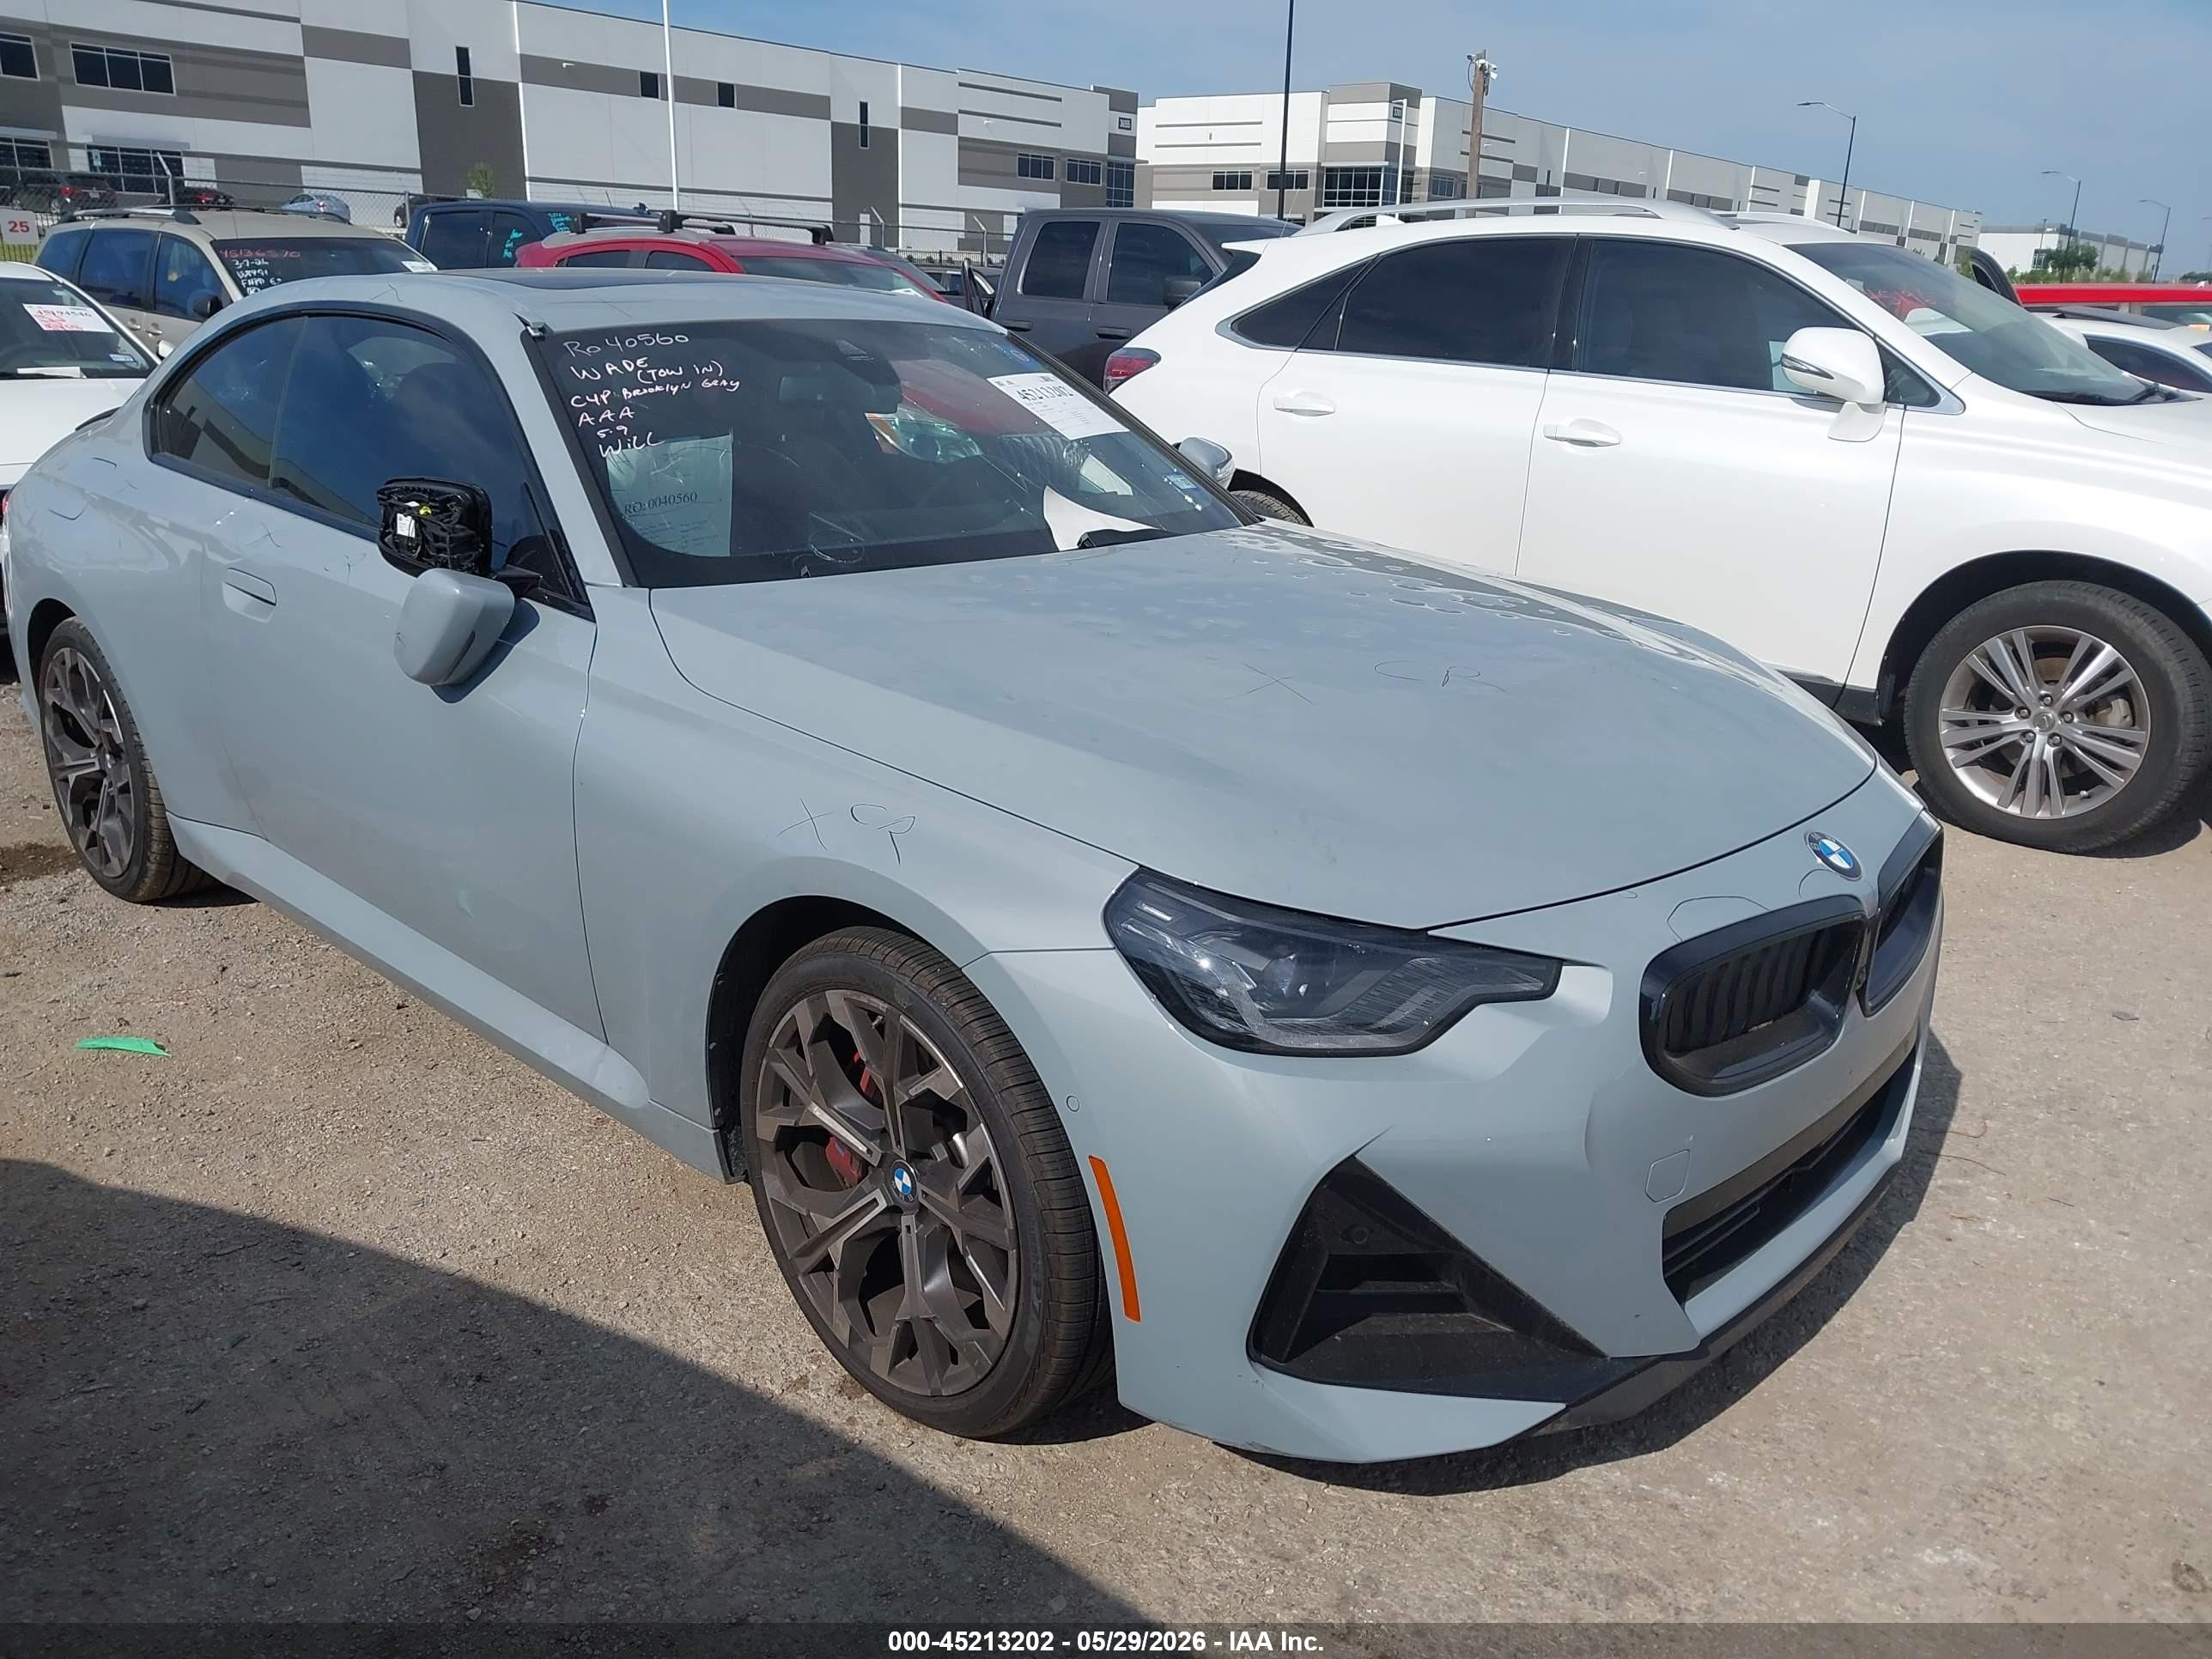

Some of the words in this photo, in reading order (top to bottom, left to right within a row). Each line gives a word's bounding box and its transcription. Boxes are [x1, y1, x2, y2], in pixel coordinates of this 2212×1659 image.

[8, 220, 30, 233] 25
[605, 332, 690, 352] 40560
[569, 356, 649, 380] WADE
[624, 490, 698, 515] RO:0040560
